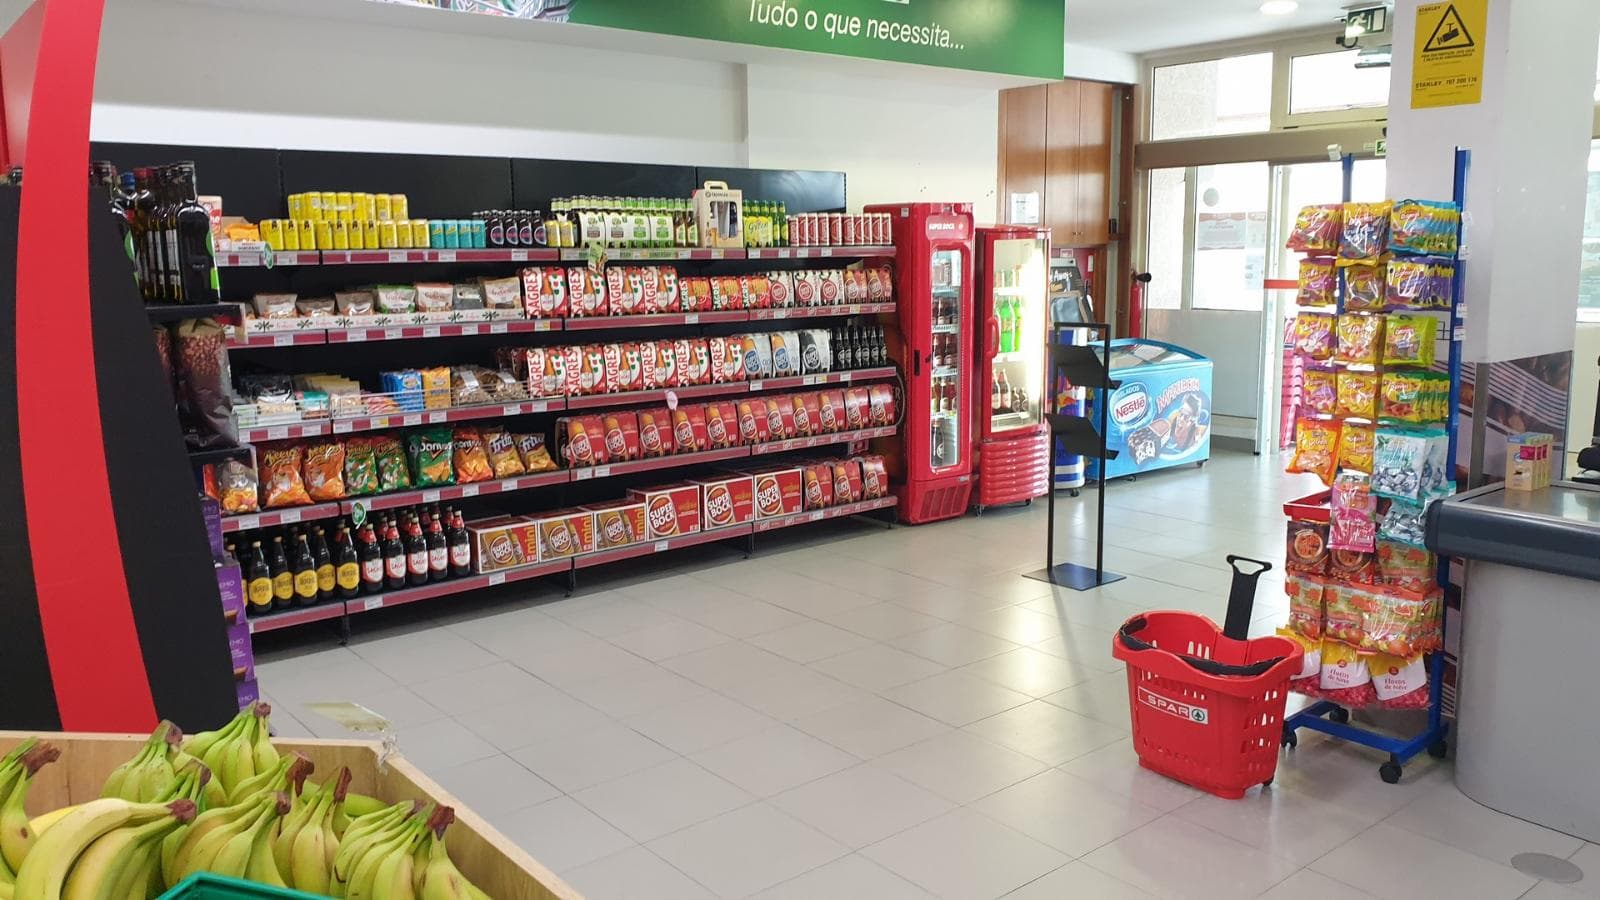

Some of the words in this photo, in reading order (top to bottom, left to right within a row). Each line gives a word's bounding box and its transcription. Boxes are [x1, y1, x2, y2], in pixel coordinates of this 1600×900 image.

[804, 10, 817, 30] o
[824, 12, 861, 39] que
[866, 19, 965, 50] necessita...
[529, 350, 544, 397] SAGRES
[566, 349, 581, 396] SAGRES
[605, 346, 619, 392] SAGRES
[641, 344, 656, 389] SAGRES
[676, 341, 690, 387] SAGRES
[711, 340, 725, 383] SAGRES
[707, 493, 730, 511] SUPER
[757, 484, 778, 501] SUPER
[649, 502, 674, 520] SUPER
[652, 511, 675, 529] BOCK
[710, 502, 732, 518] BOCK
[524, 525, 536, 555] mini
[581, 516, 592, 545] mini
[1147, 694, 1189, 717] SPAR
